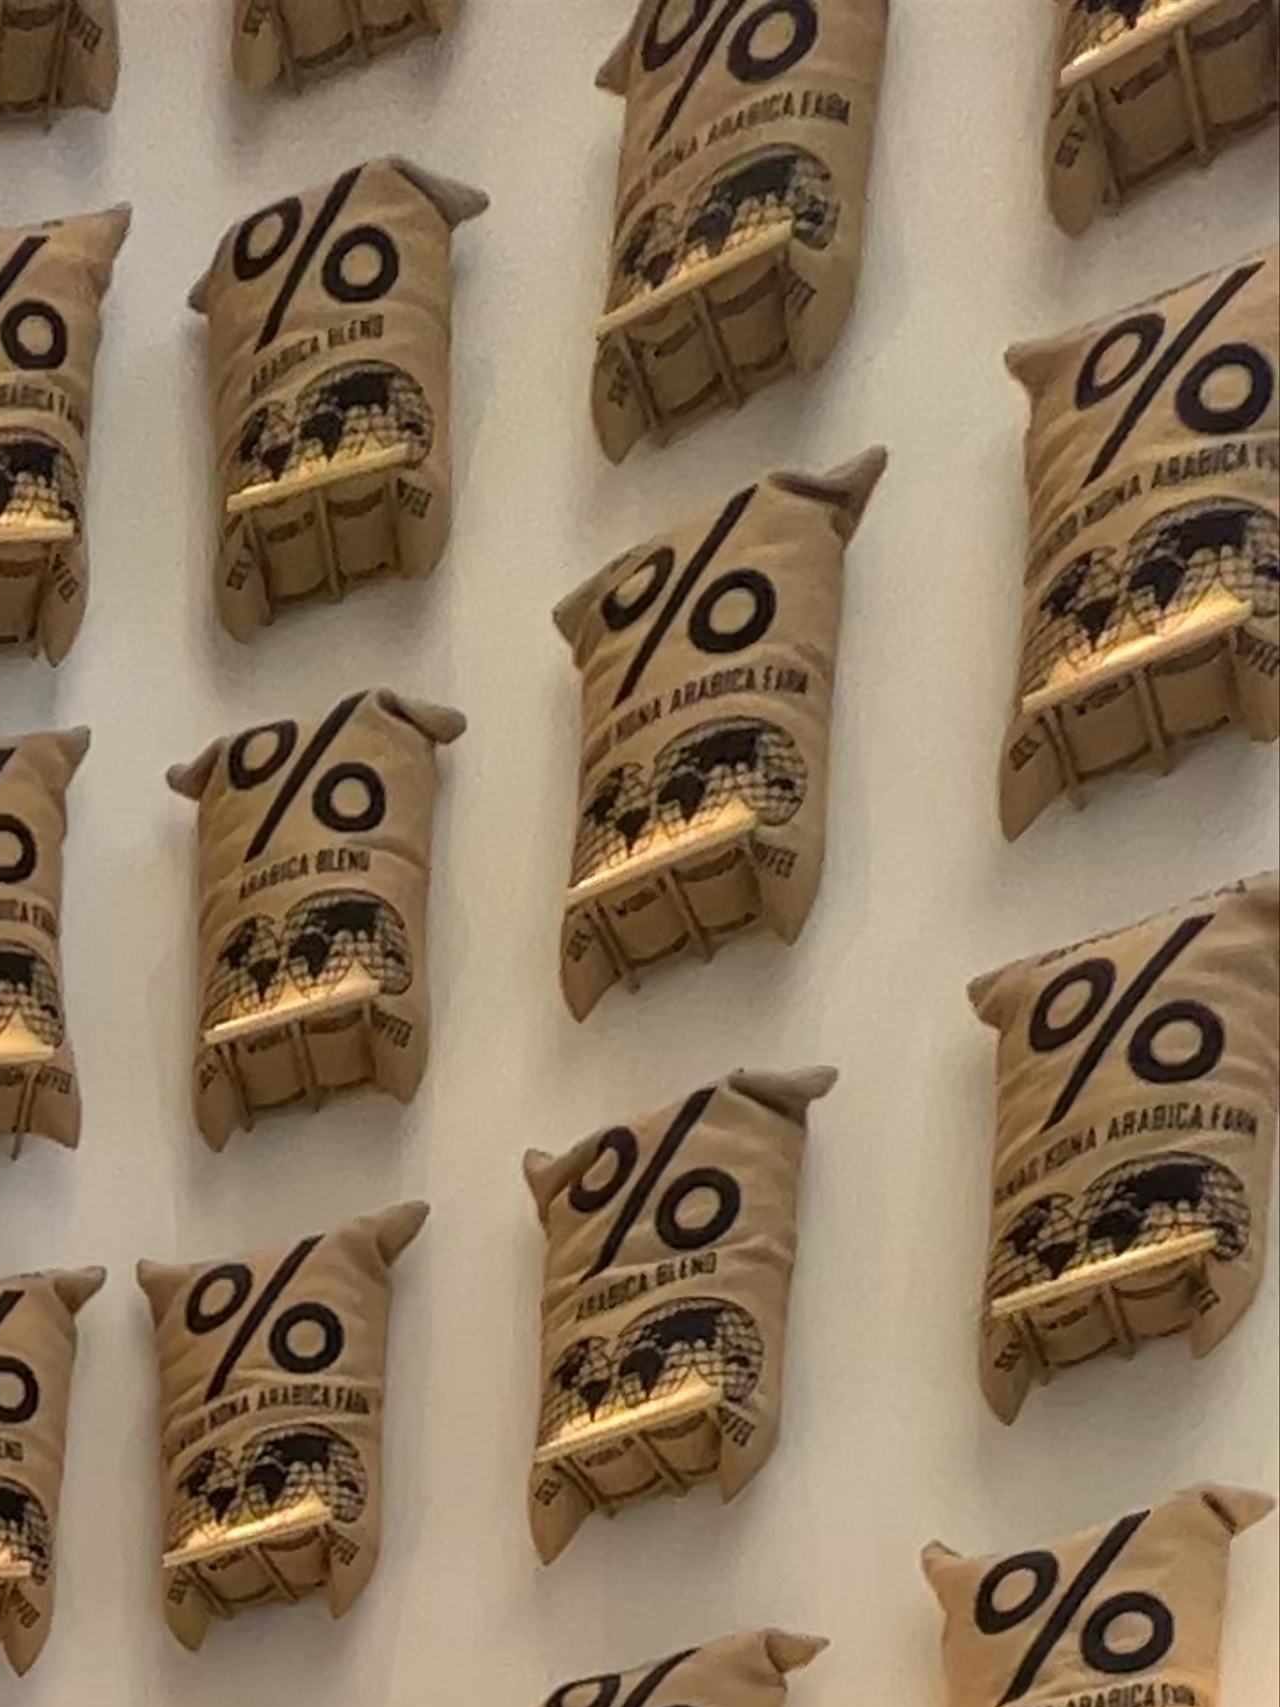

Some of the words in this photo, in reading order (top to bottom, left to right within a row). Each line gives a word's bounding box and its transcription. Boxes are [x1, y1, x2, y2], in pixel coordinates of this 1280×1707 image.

[706, 95, 796, 149] ARABICA
[1151, 444, 1249, 489] ARABICA
[670, 667, 756, 714] ARABICA
[240, 854, 308, 899] ARABICA
[1107, 1105, 1202, 1141] ARABICA
[577, 1272, 649, 1321] ARABICA
[257, 1384, 330, 1411] ARABICA
